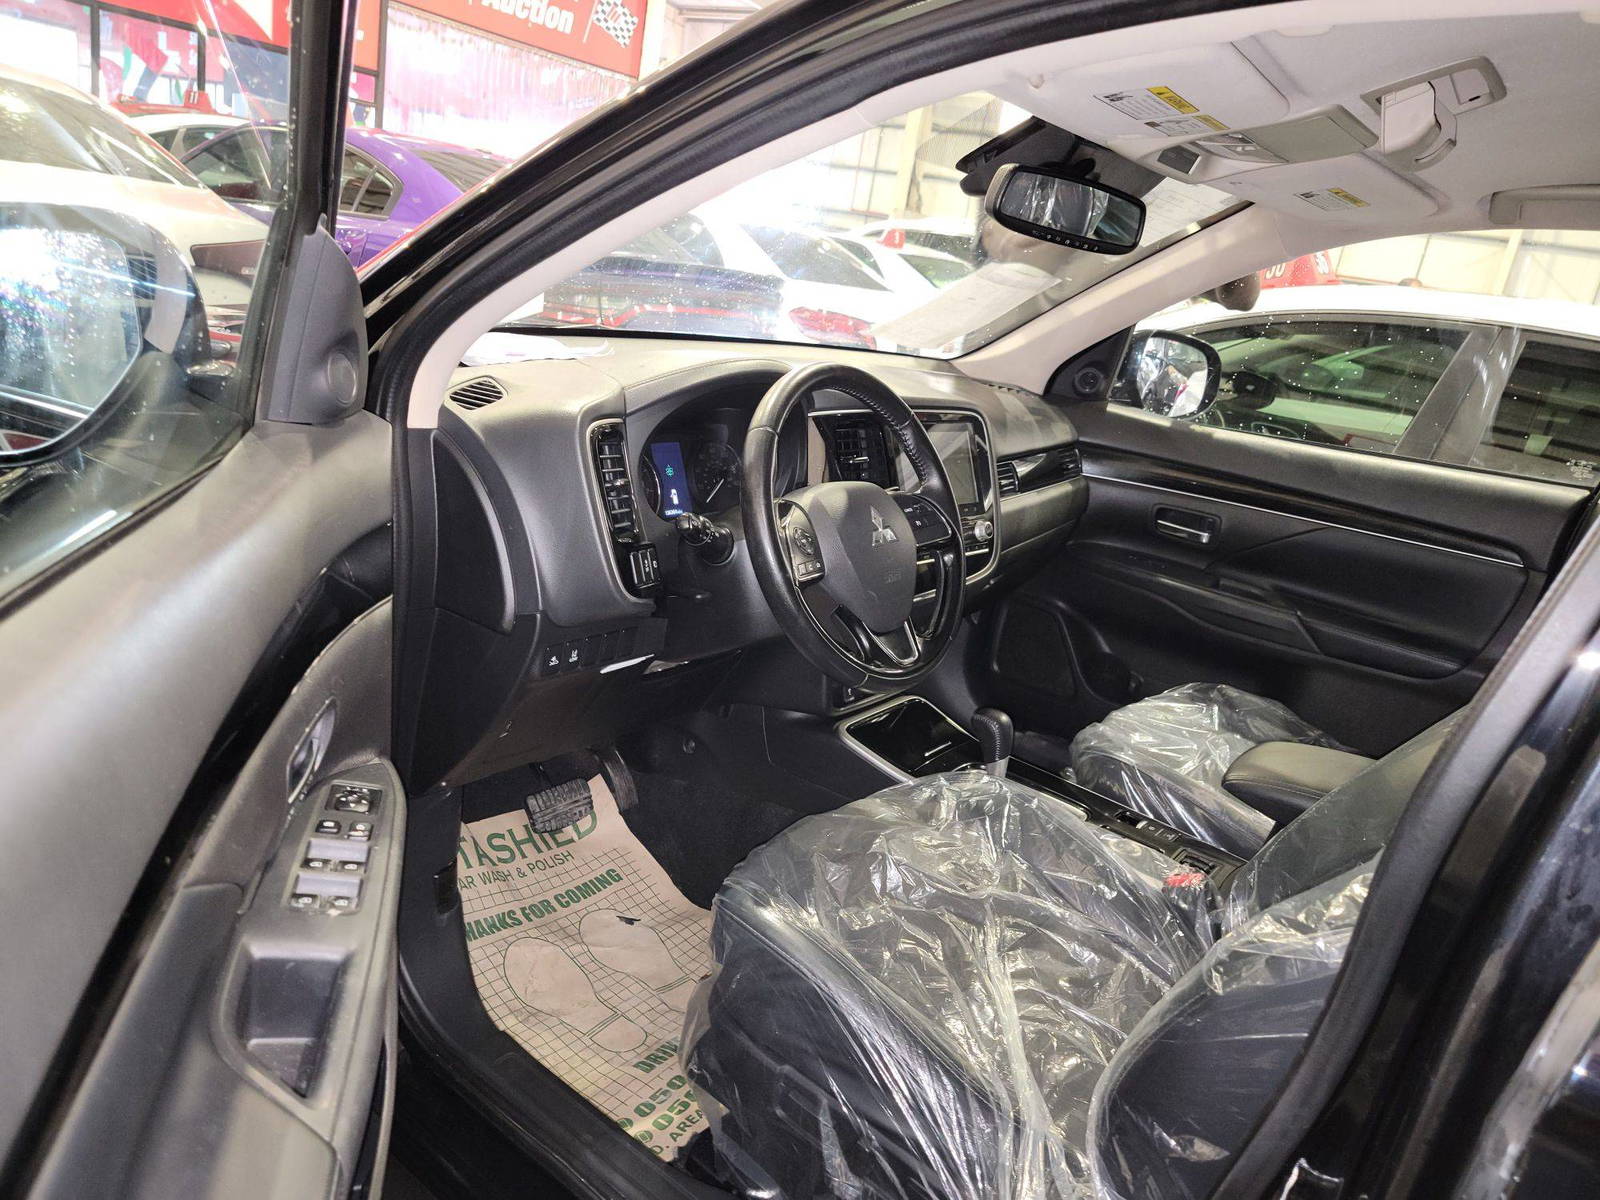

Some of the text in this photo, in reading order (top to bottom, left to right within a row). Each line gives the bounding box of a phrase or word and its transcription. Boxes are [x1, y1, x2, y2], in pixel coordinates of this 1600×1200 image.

[478, 869, 514, 885] WASH
[516, 867, 528, 879] &
[527, 850, 575, 873] POLISH
[520, 898, 557, 922] FOR
[554, 868, 624, 908] COMING
